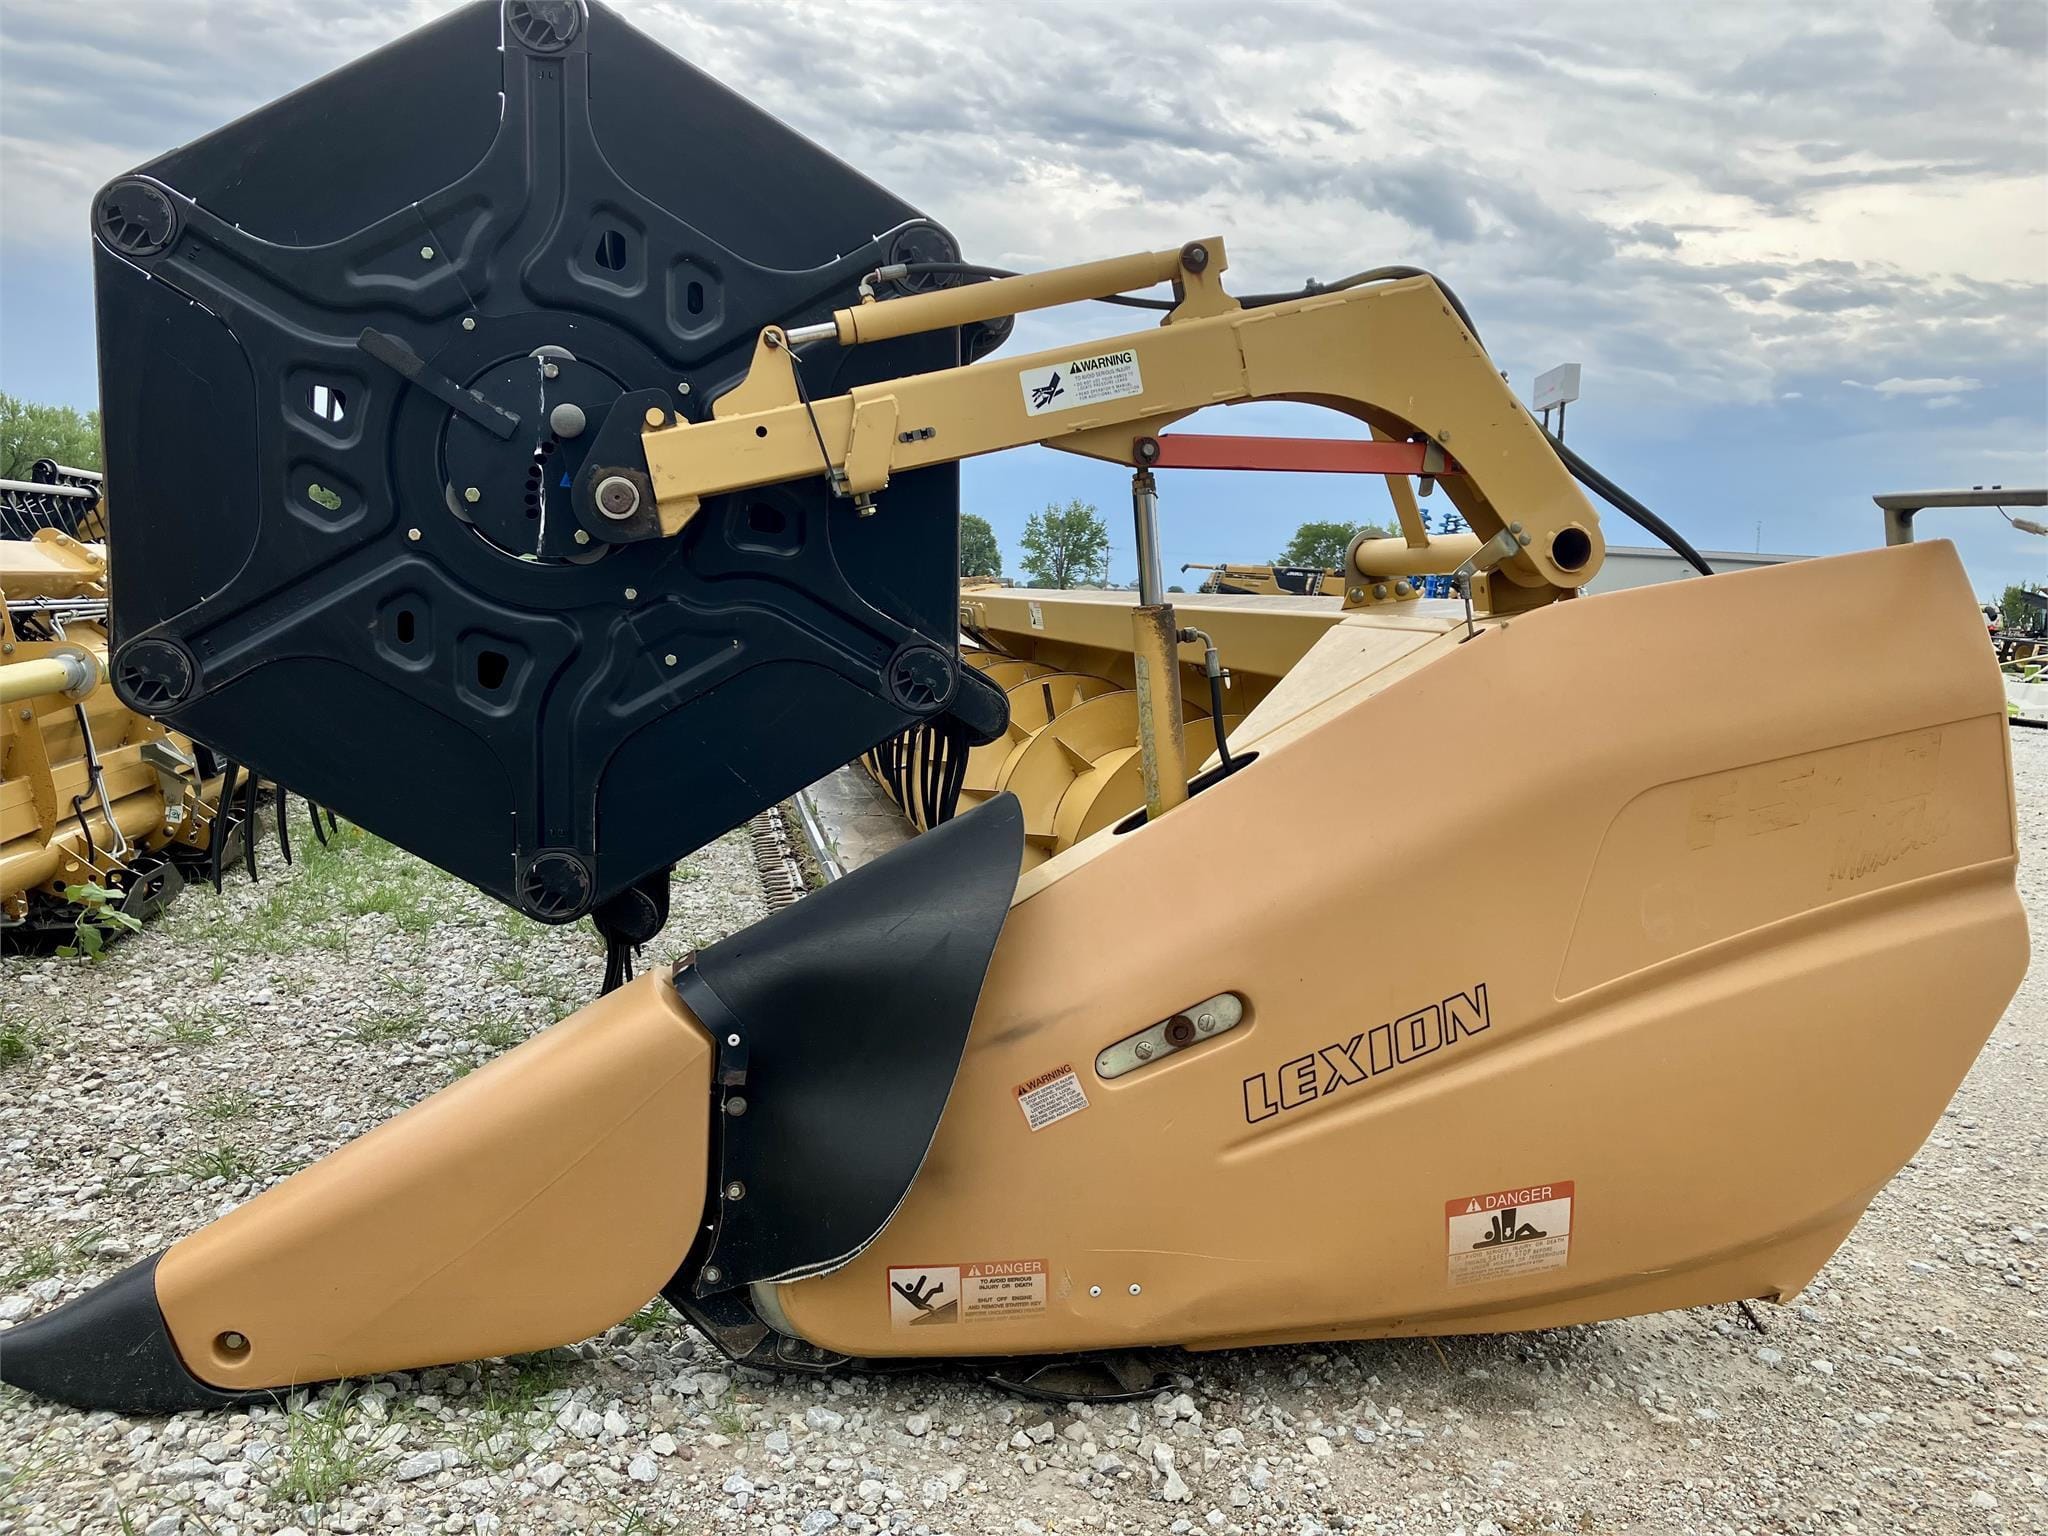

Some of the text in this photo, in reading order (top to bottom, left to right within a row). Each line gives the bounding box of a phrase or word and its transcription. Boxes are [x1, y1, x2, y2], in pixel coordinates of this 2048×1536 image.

[1080, 352, 1132, 371] WARNING
[1243, 983, 1490, 1124] LEXION
[1026, 1064, 1072, 1090] WARNING
[1027, 1090, 1041, 1099] AVOID
[1040, 1082, 1059, 1093] SERIOUS
[1025, 1097, 1037, 1105] STOP
[1030, 1104, 1046, 1113] LISTEN
[1038, 1101, 1062, 1115] MOVEMENT
[1069, 1092, 1081, 1100] STOP
[1031, 1113, 1048, 1124] BEFORE
[1048, 1104, 1068, 1115] OPENING
[1486, 1186, 1552, 1208] DANGER
[1489, 1253, 1512, 1261] SAFETY
[985, 1262, 1041, 1274] DANGER
